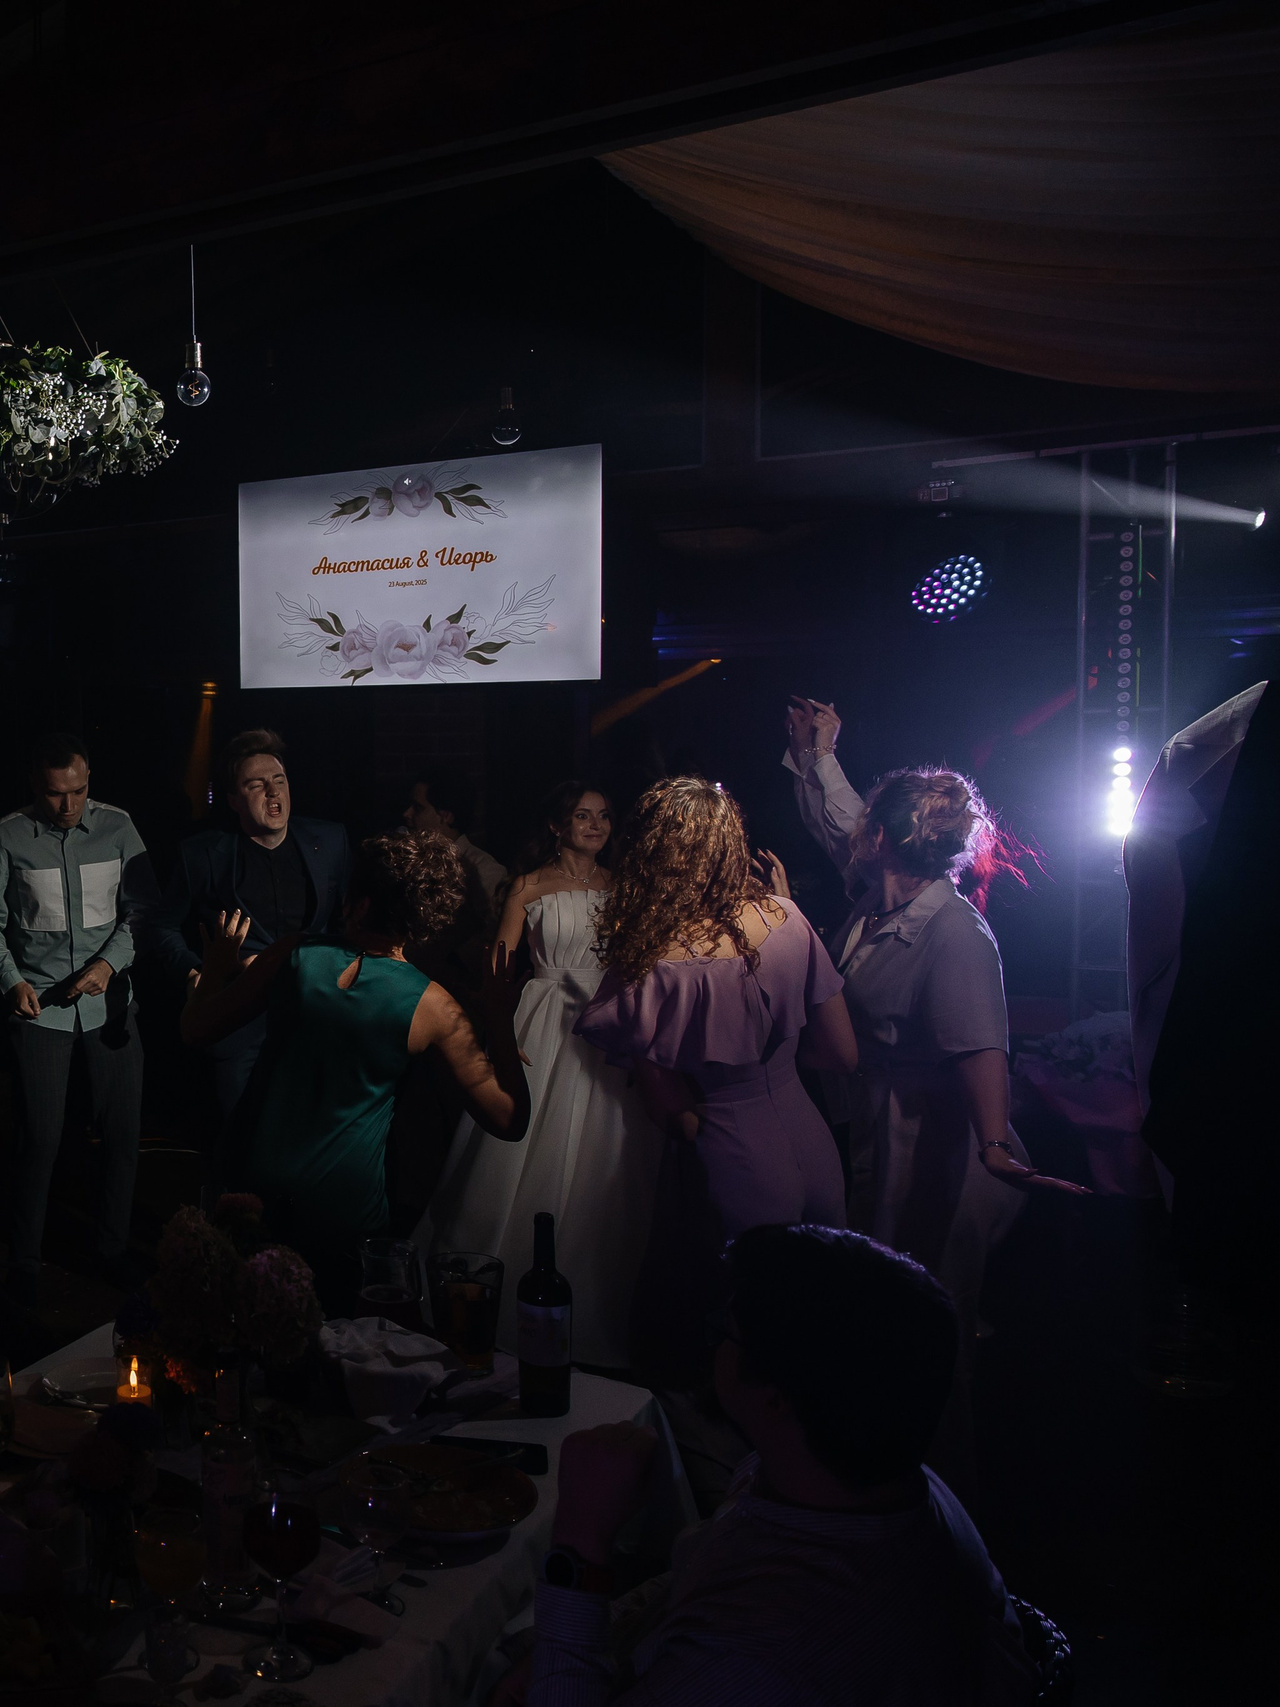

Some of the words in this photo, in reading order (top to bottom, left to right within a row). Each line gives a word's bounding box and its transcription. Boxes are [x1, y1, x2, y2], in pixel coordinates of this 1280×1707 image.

[311, 555, 415, 576] Анастасия
[416, 549, 430, 569] &
[434, 546, 498, 573] Игорь
[395, 580, 414, 588] August,
[414, 578, 428, 586] 2025
